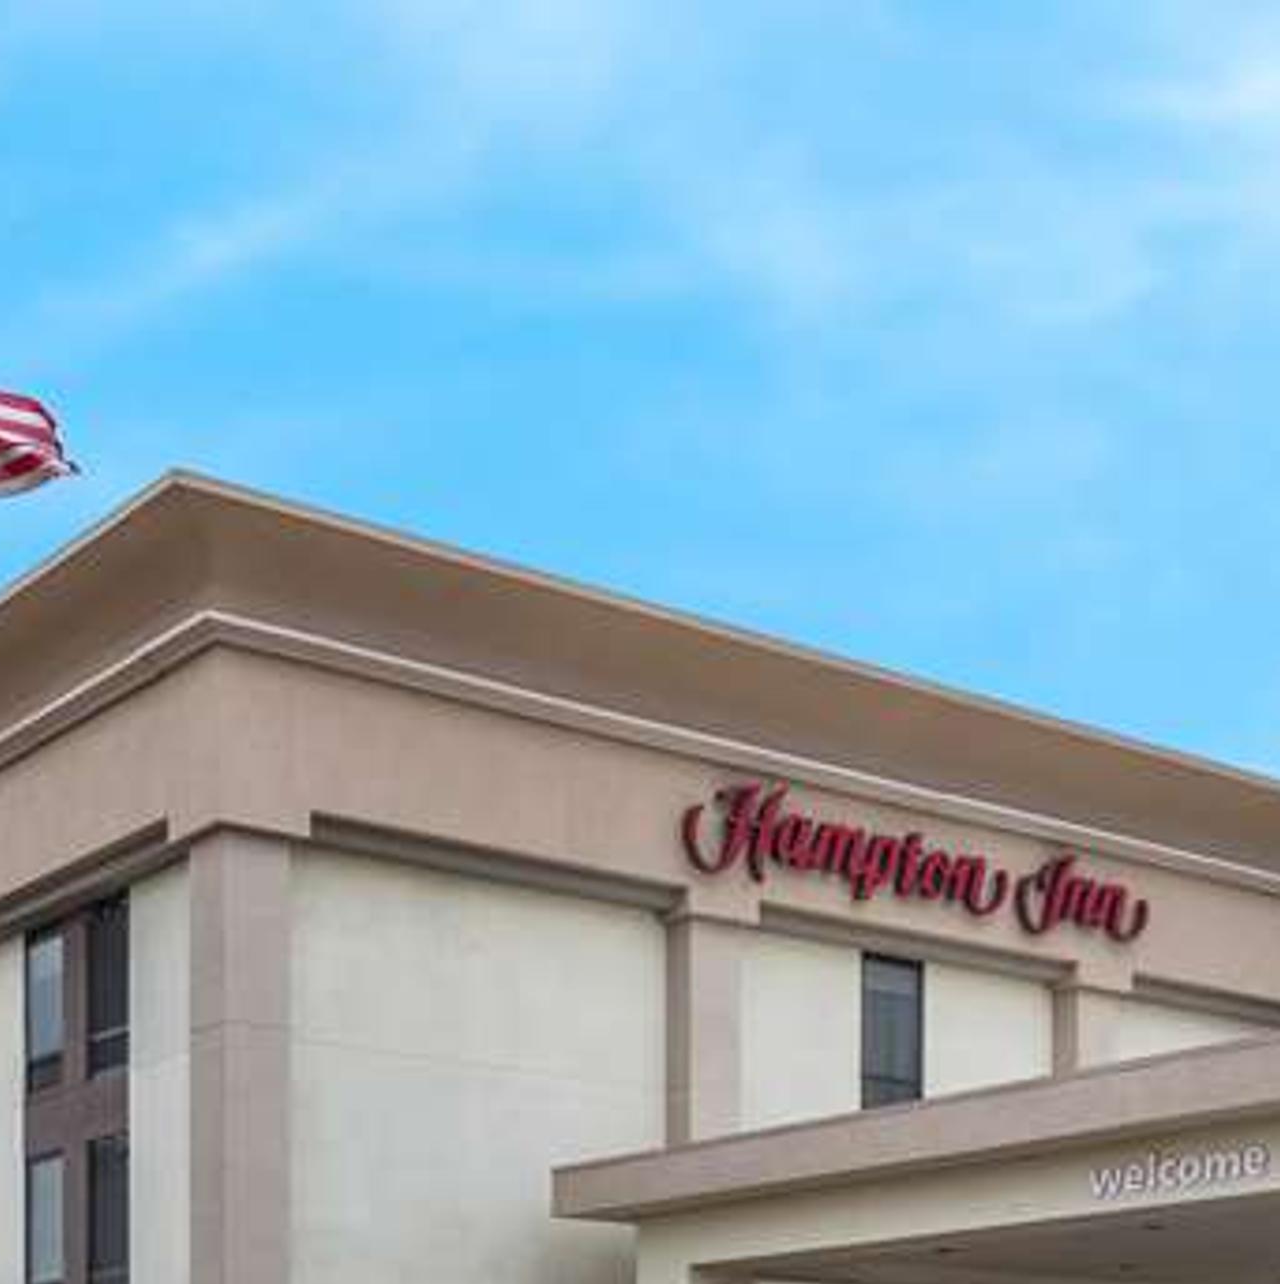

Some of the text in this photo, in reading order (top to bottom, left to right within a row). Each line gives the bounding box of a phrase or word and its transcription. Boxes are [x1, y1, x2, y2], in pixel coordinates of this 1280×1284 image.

[683, 779, 1147, 942] Hampton Inn
[1089, 1146, 1267, 1200] welcome
